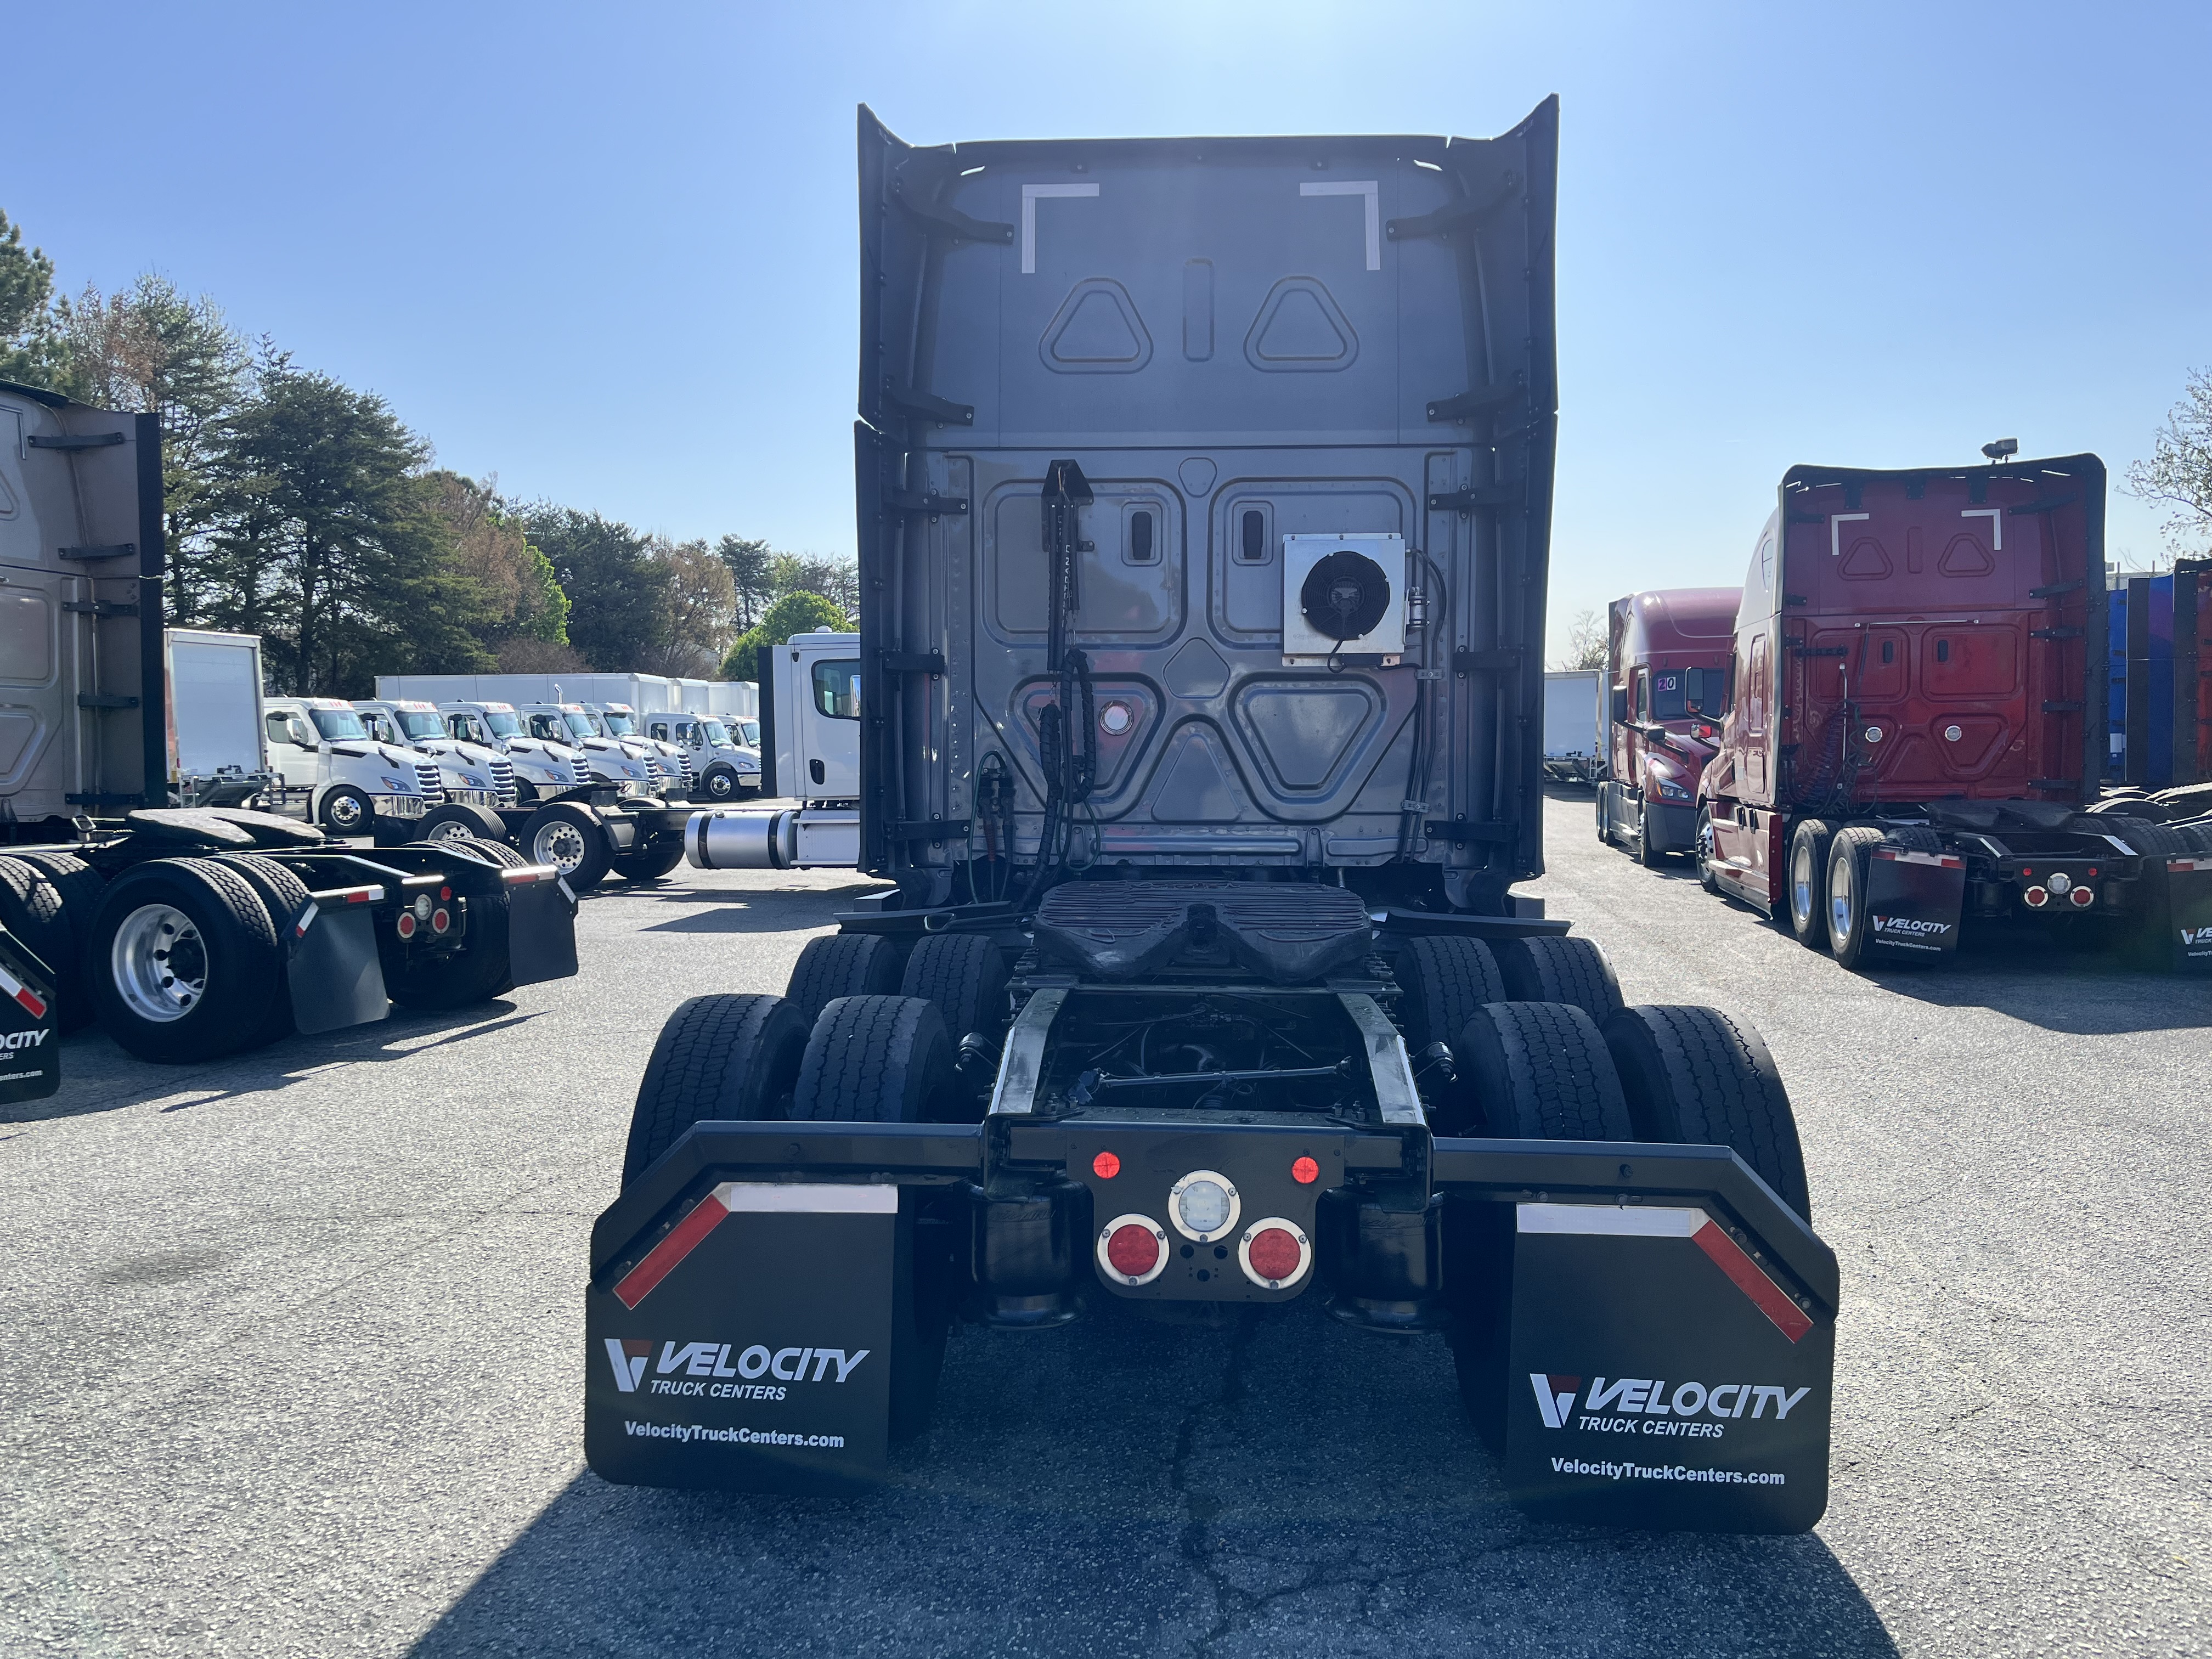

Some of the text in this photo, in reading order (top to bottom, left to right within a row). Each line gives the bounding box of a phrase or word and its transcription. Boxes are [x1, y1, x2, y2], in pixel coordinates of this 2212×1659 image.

[1659, 678, 1674, 690] 20
[1886, 917, 1952, 934] VELOCITY
[1875, 938, 1942, 951] VelocityTruckCenters.com
[656, 1341, 871, 1383] VELOCITY
[650, 1379, 787, 1401] TRUCK CENTERS
[1585, 1376, 1812, 1420] VELOCITY
[624, 1420, 844, 1448] VelocityTruckCenters.com
[1579, 1416, 1724, 1438] TRUCK CENTERS
[1551, 1457, 1785, 1485] VelocityTruckCenters.com
